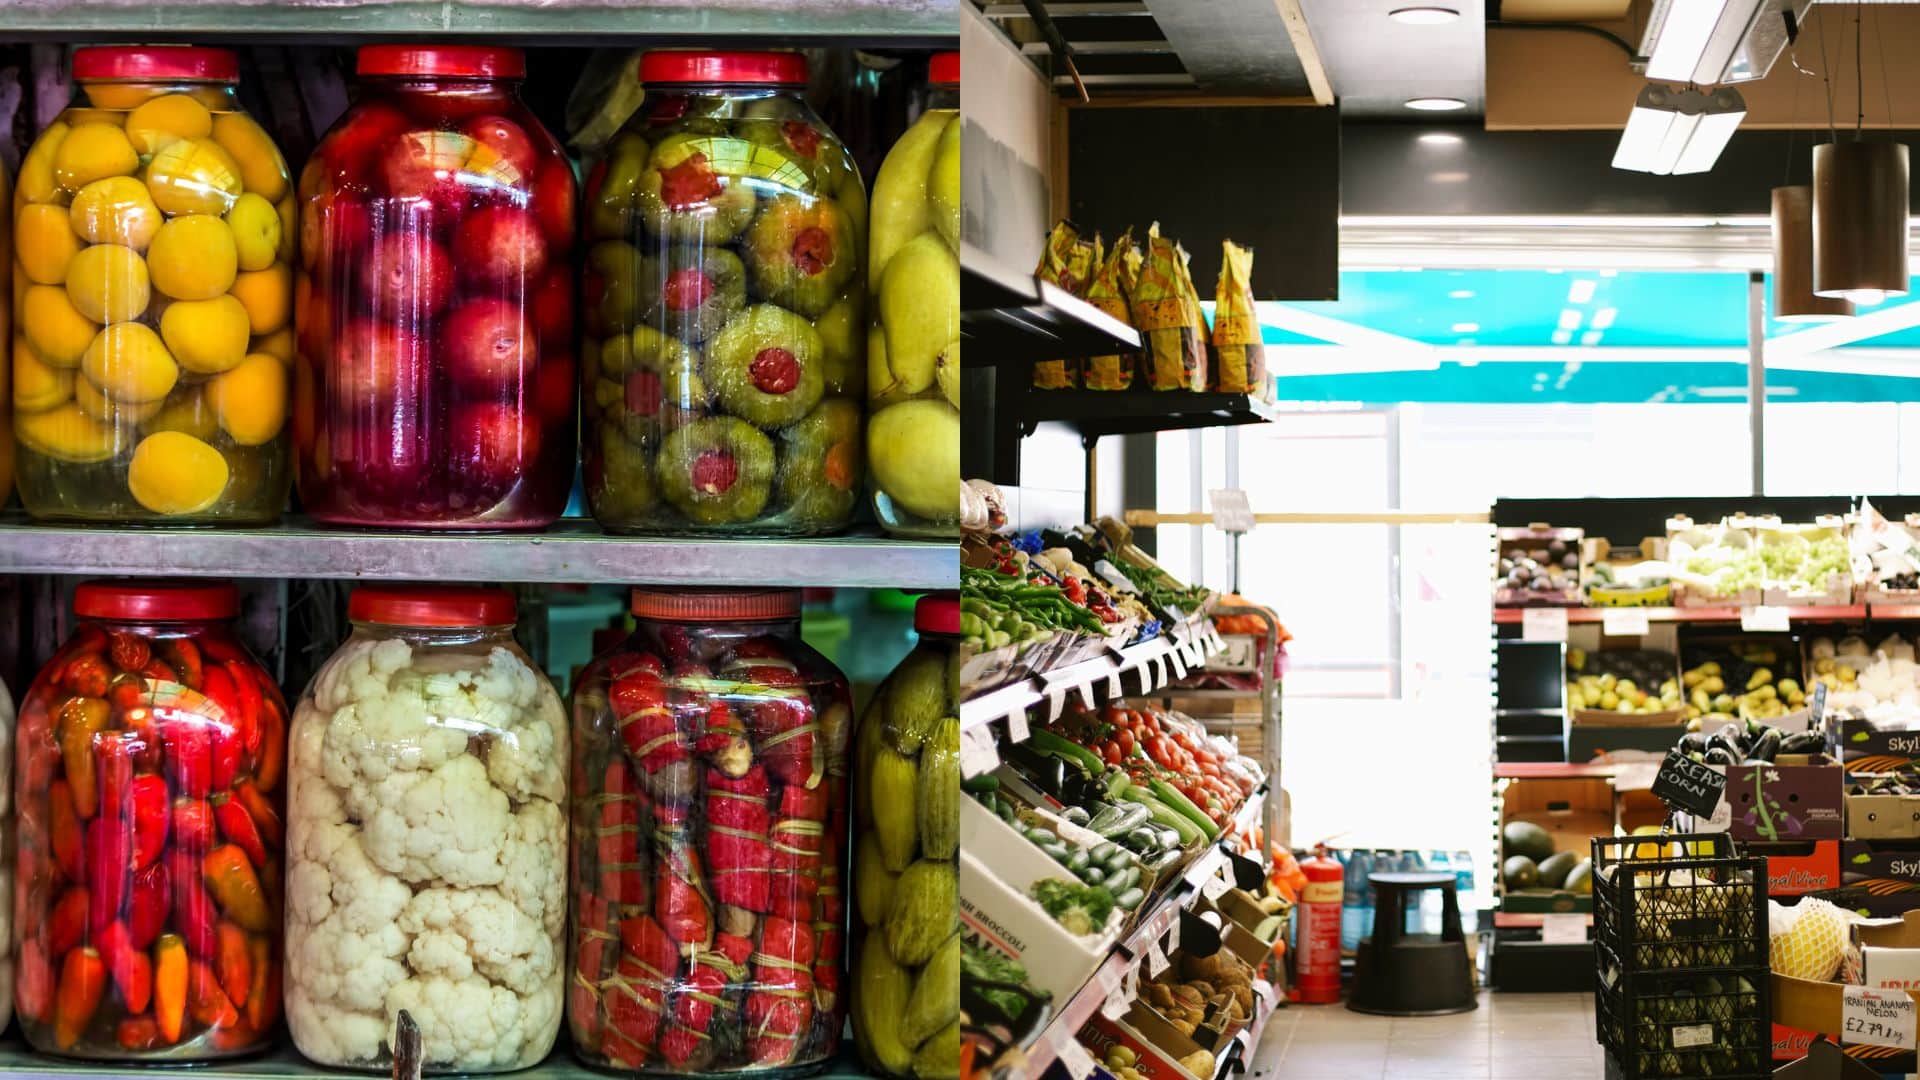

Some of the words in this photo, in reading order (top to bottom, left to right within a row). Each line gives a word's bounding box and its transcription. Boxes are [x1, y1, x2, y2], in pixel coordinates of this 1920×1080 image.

[1660, 769, 1706, 797] CORN
[975, 910, 1027, 952] BROCCOLI
[1866, 1007, 1898, 1018] MELON
